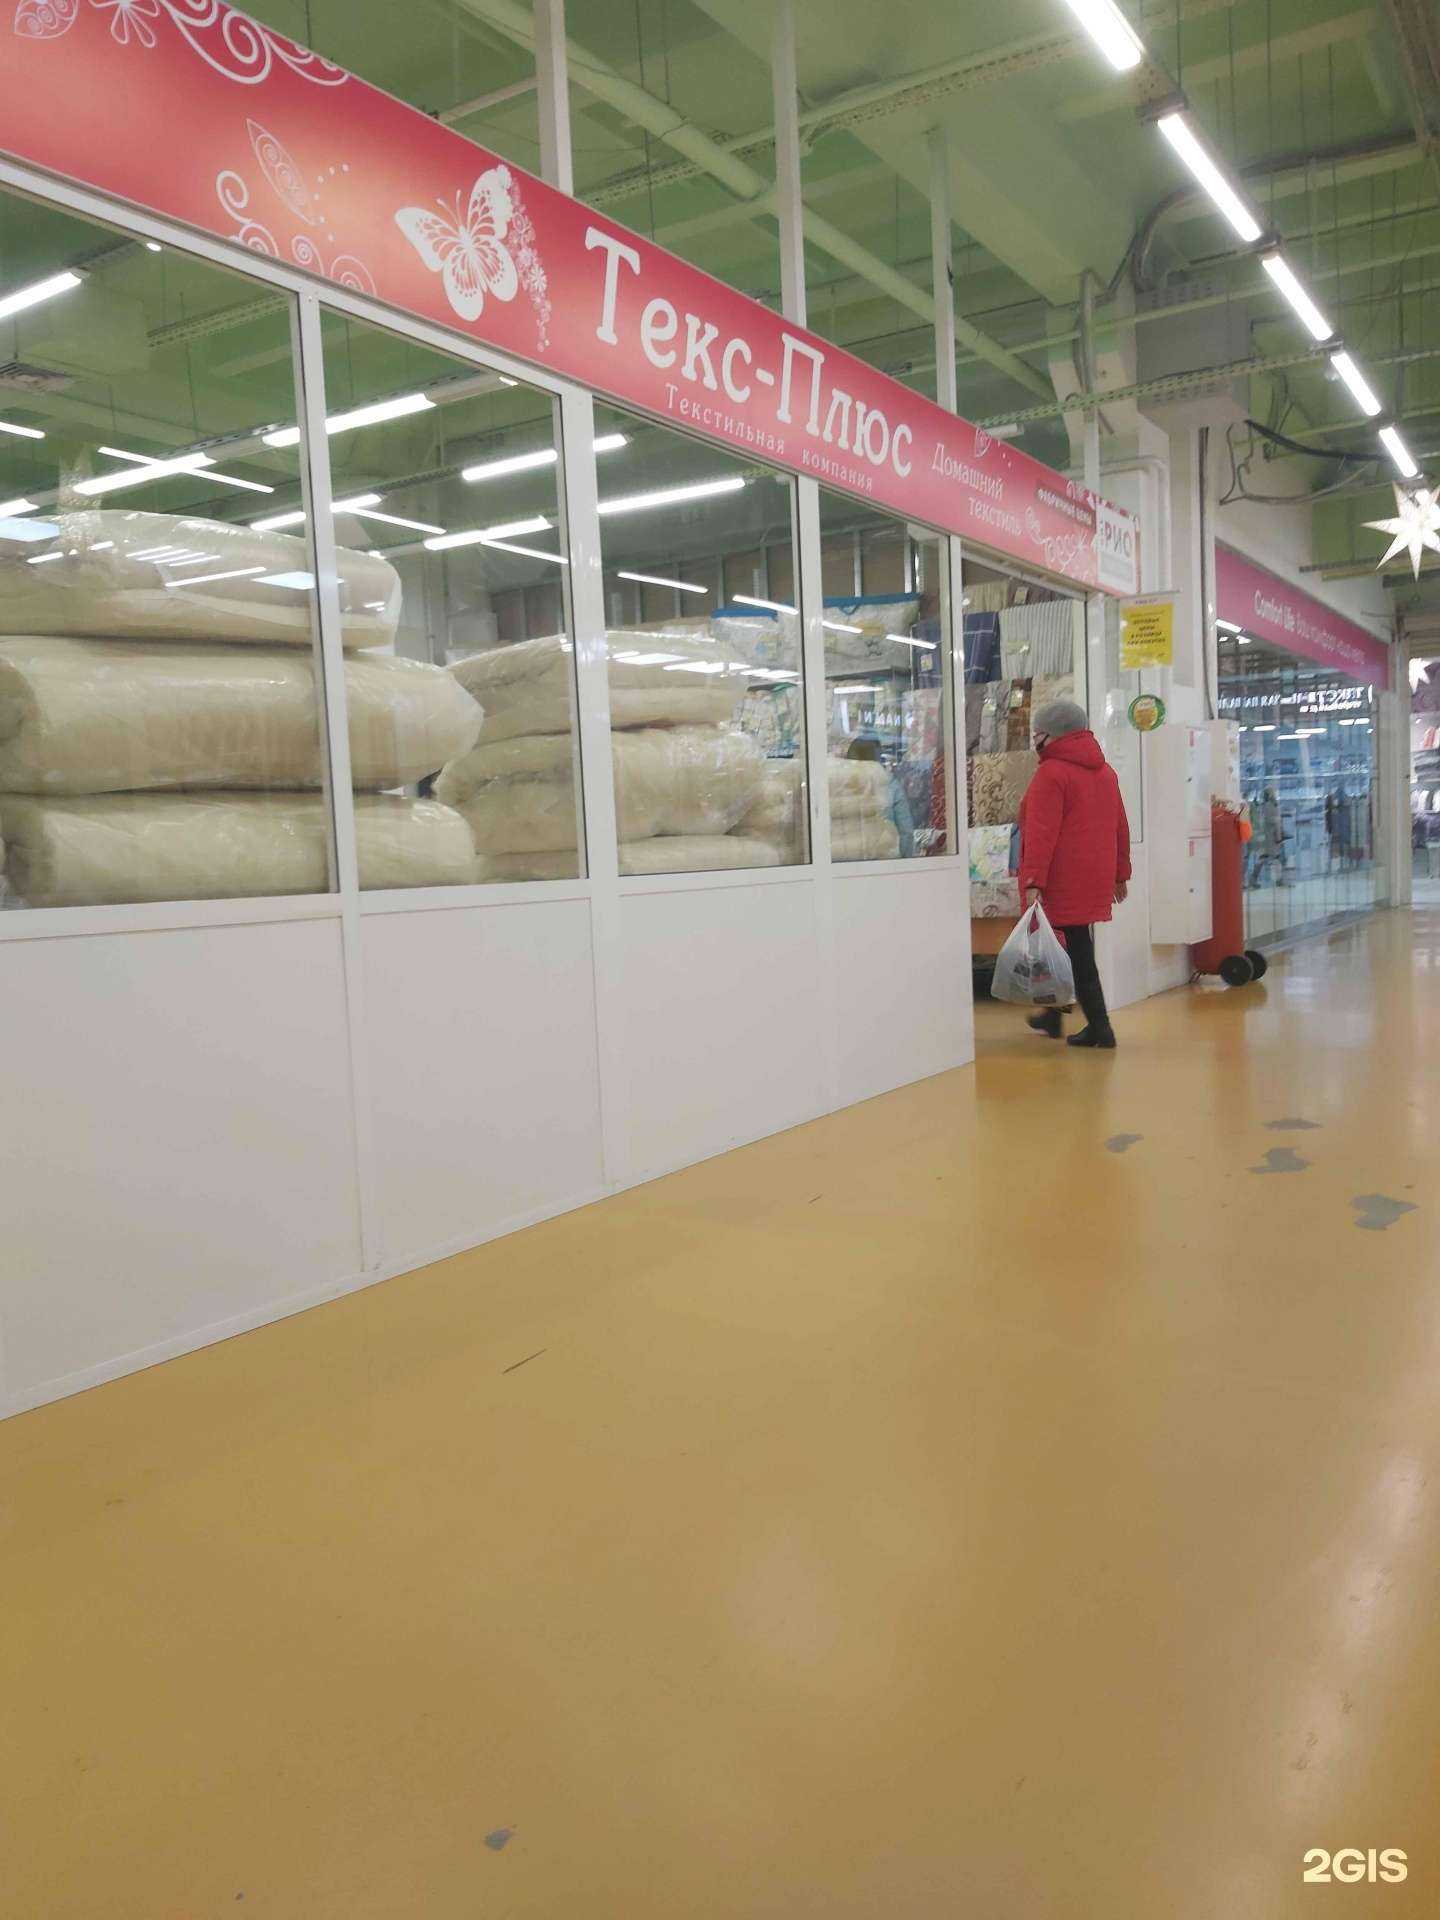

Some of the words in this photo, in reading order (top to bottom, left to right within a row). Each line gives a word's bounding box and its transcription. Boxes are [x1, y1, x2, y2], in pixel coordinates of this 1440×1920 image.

[584, 226, 913, 478] Текс-Плюс
[664, 383, 785, 455] Текстильная
[802, 448, 873, 491] компания
[931, 442, 1003, 500] Домашний
[968, 496, 1022, 537] текстиль
